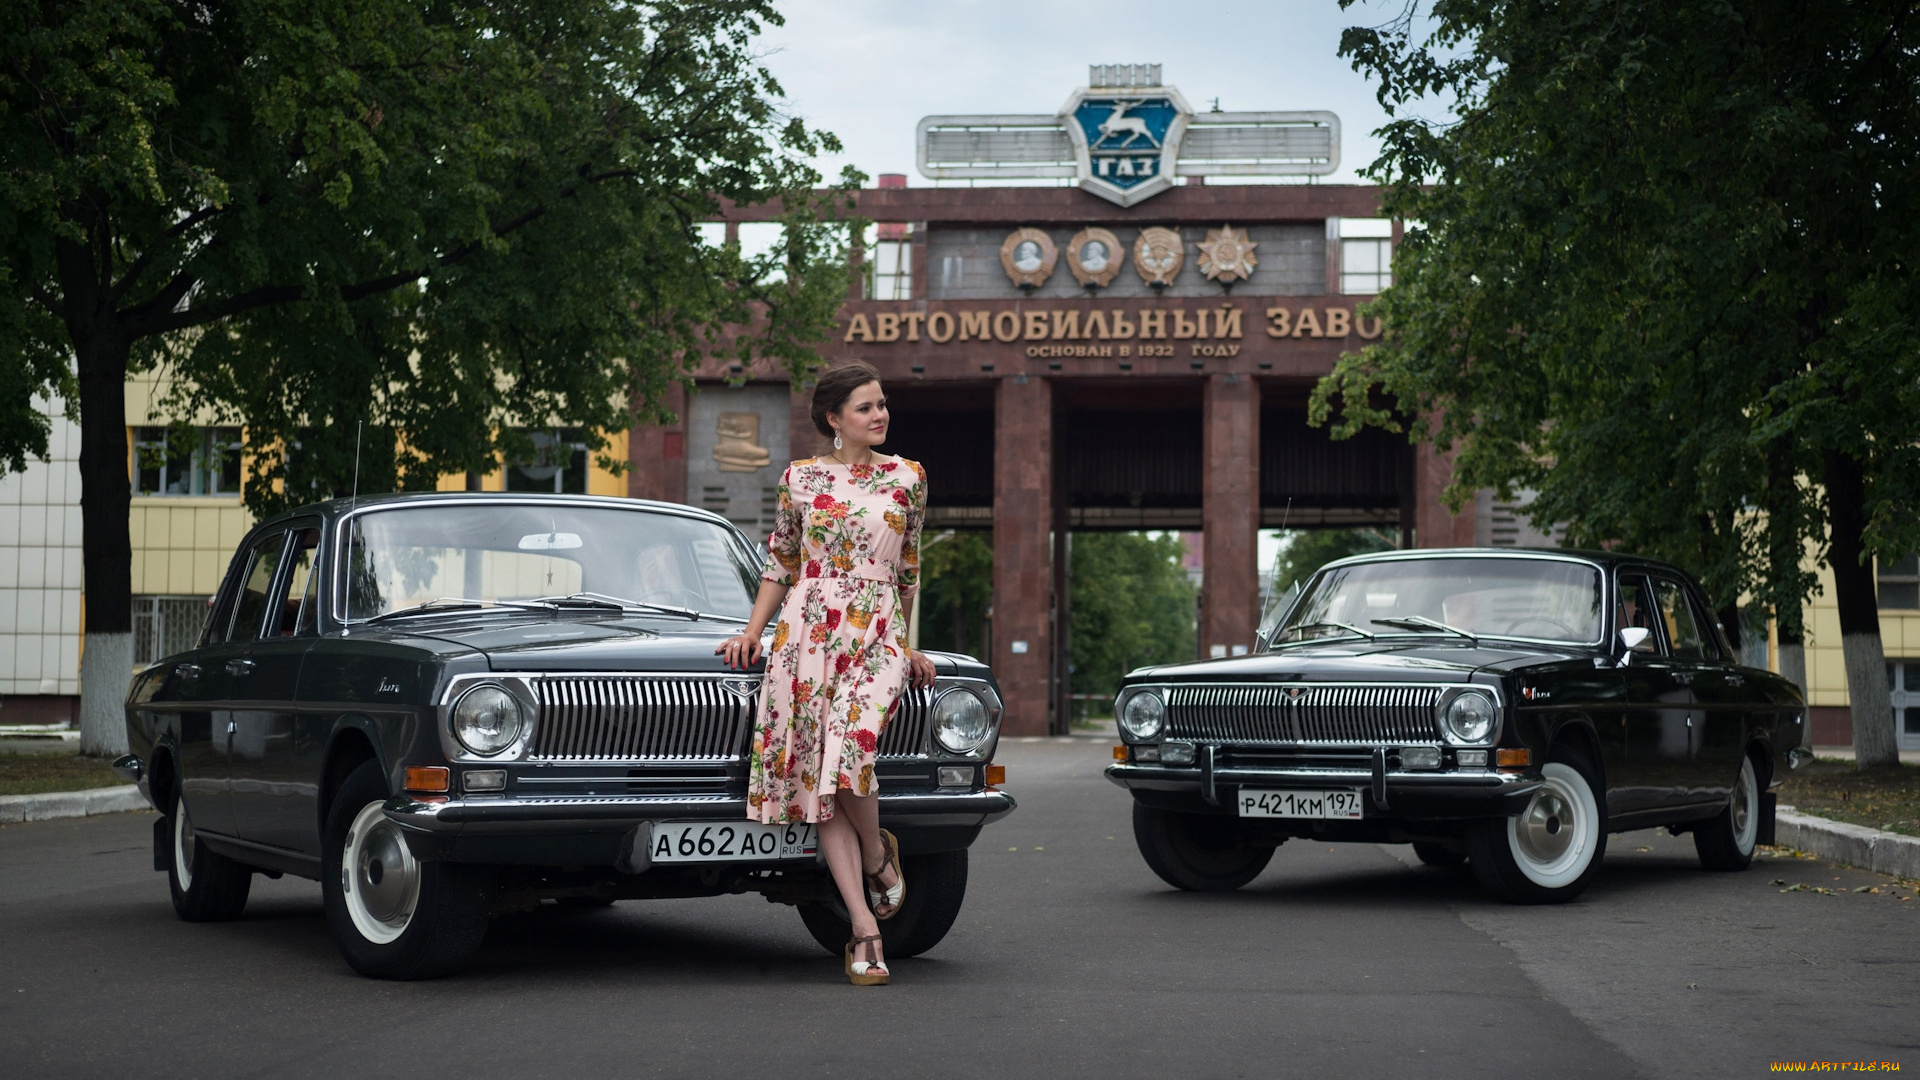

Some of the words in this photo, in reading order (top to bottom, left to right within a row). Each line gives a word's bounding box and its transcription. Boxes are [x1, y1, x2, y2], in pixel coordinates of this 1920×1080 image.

[1098, 157, 1154, 176] ГАЗ
[844, 303, 1244, 343] АВТОМОБИЛЬНЫЙ
[1026, 345, 1113, 357] ОСНОВАН
[1119, 345, 1130, 357] В
[1138, 344, 1175, 357] 1932
[1191, 344, 1241, 357] ГОДУ
[1326, 793, 1356, 810] 197
[784, 823, 812, 845] 67
[782, 846, 802, 855] RUS
